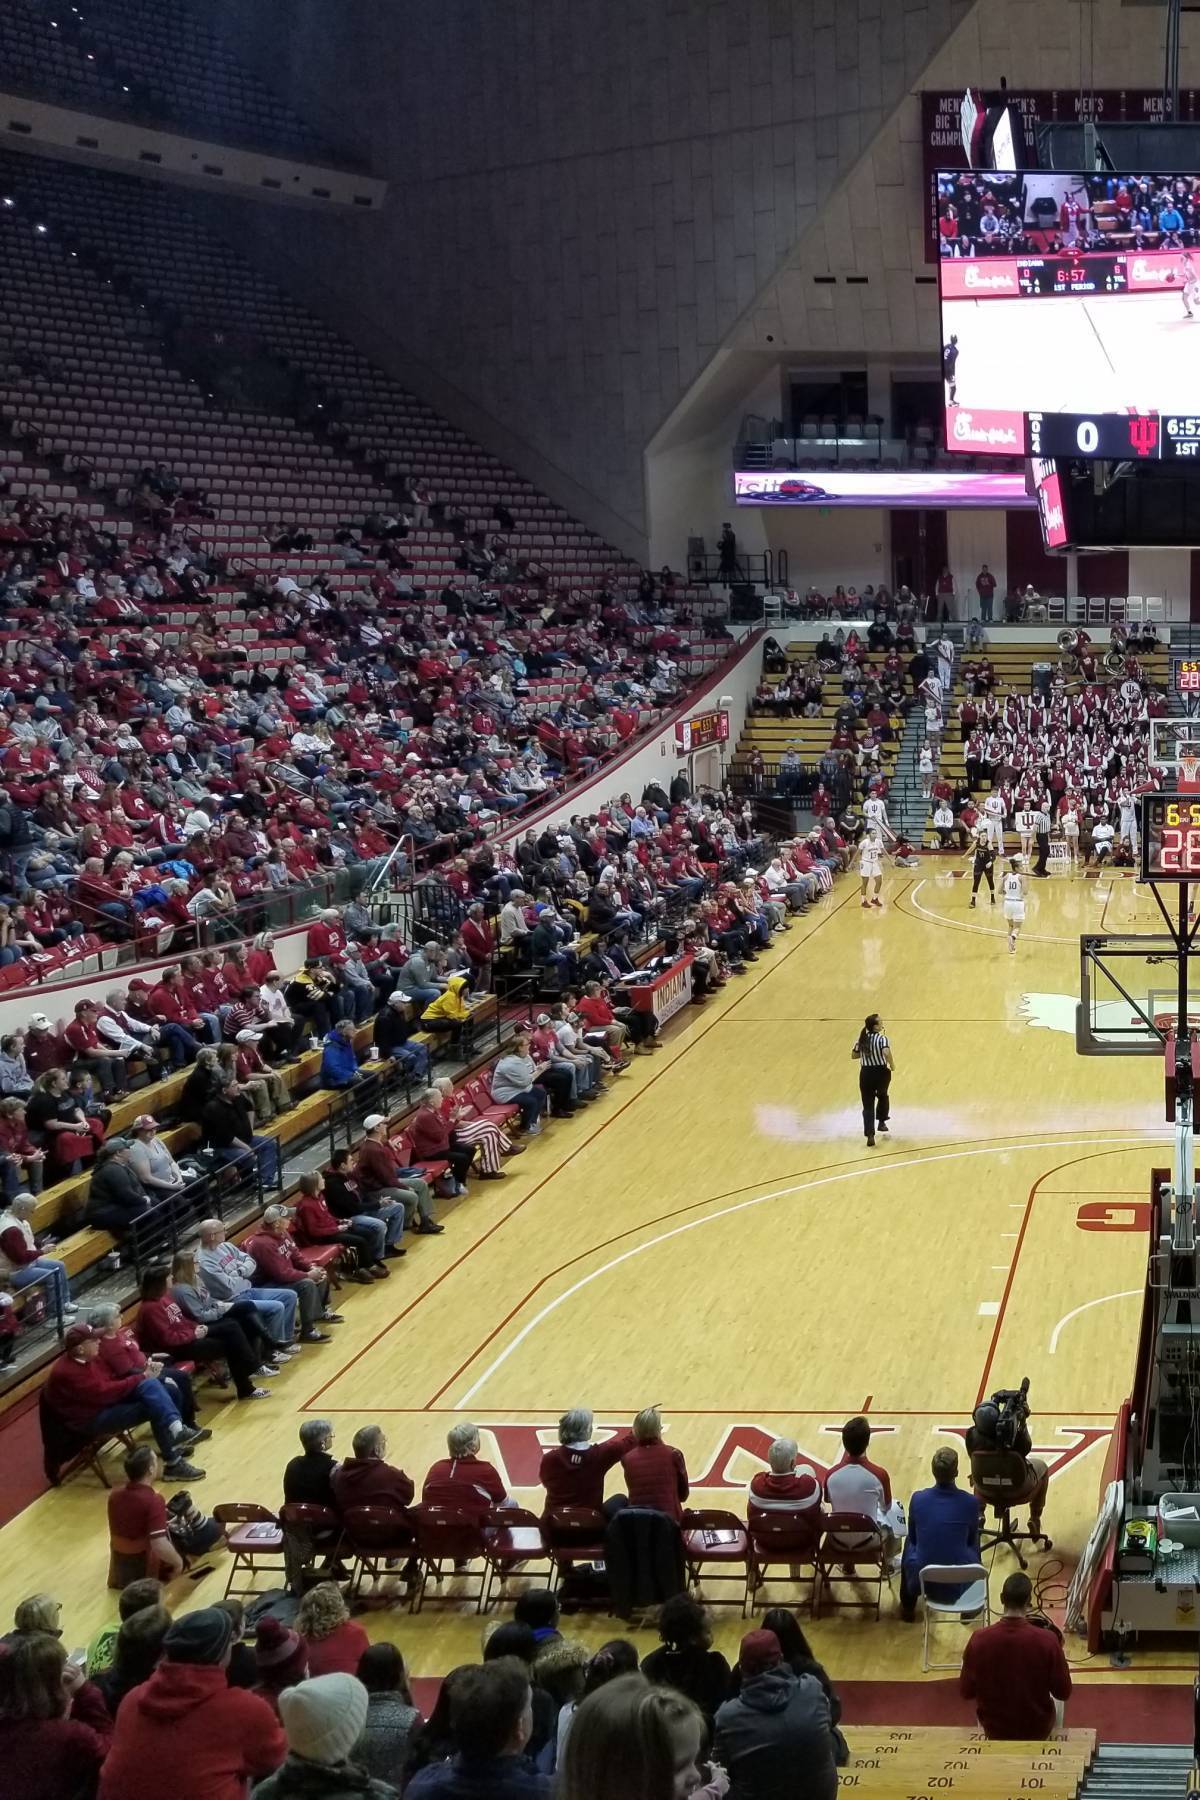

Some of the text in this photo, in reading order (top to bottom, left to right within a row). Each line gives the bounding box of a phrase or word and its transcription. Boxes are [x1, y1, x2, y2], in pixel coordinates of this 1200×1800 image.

[940, 98, 963, 112] MEN'
[1074, 98, 1104, 113] MEN'S
[935, 115, 950, 129] BIG
[1024, 269, 1030, 277] 0
[1057, 270, 1086, 282] 6:57
[1031, 420, 1041, 433] 0
[1076, 421, 1099, 452] 0
[1129, 416, 1159, 455] IU
[1031, 440, 1041, 453] 4
[1175, 442, 1198, 455] 1ST
[1180, 672, 1199, 688] 28
[1009, 881, 1017, 890] 10
[657, 969, 687, 1012] INDIANA
[855, 1759, 881, 1769] 103
[944, 1761, 970, 1769] 102
[1031, 1762, 1056, 1771] 101
[927, 1777, 955, 1788] 102
[1020, 1778, 1047, 1789] 101
